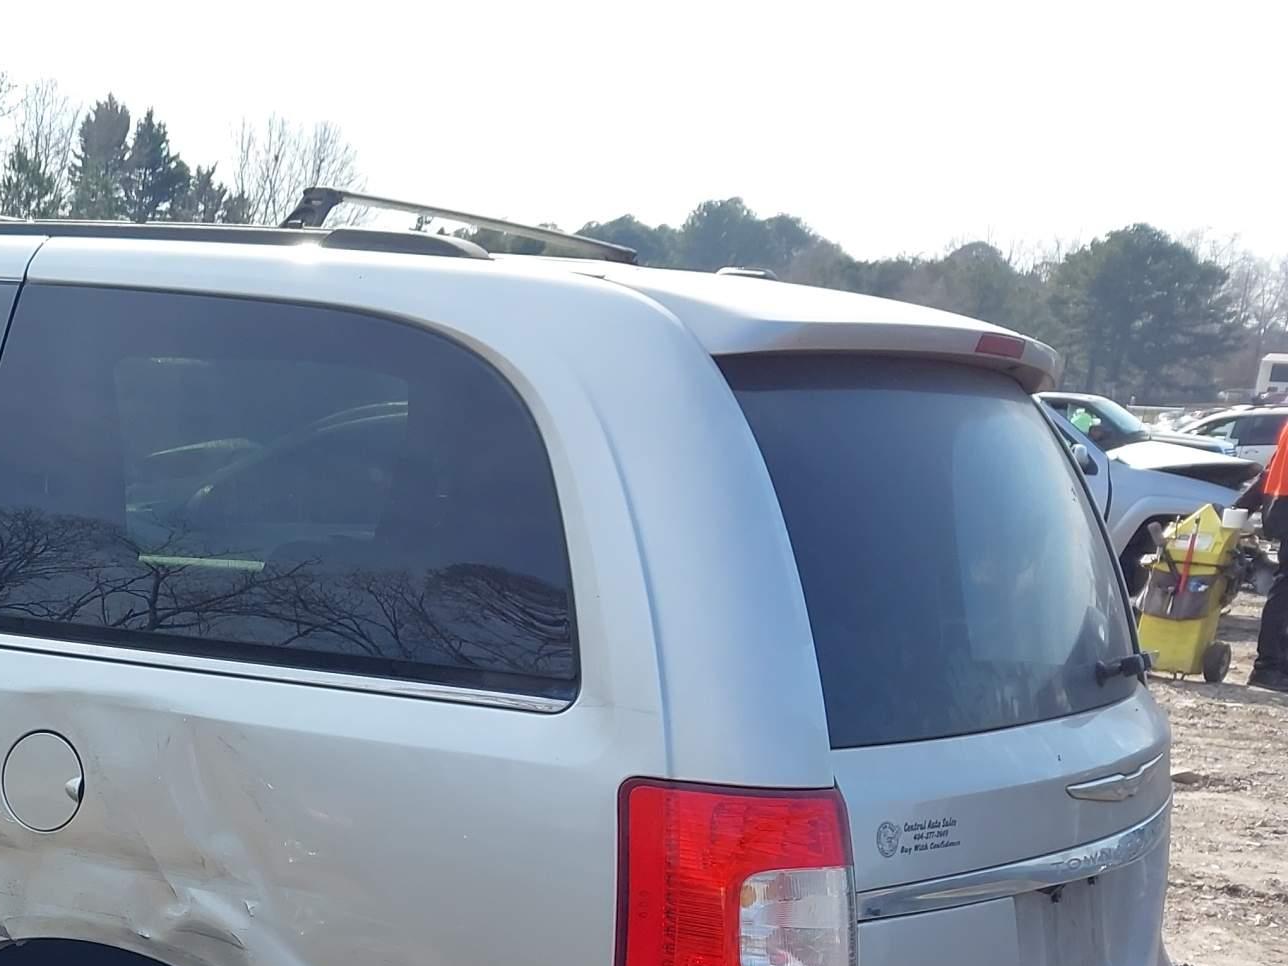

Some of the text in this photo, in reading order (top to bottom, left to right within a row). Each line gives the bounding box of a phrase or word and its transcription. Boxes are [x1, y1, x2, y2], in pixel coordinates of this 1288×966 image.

[903, 820, 927, 832] Central
[928, 819, 941, 829] Auto
[1050, 847, 1112, 874] TOWN
